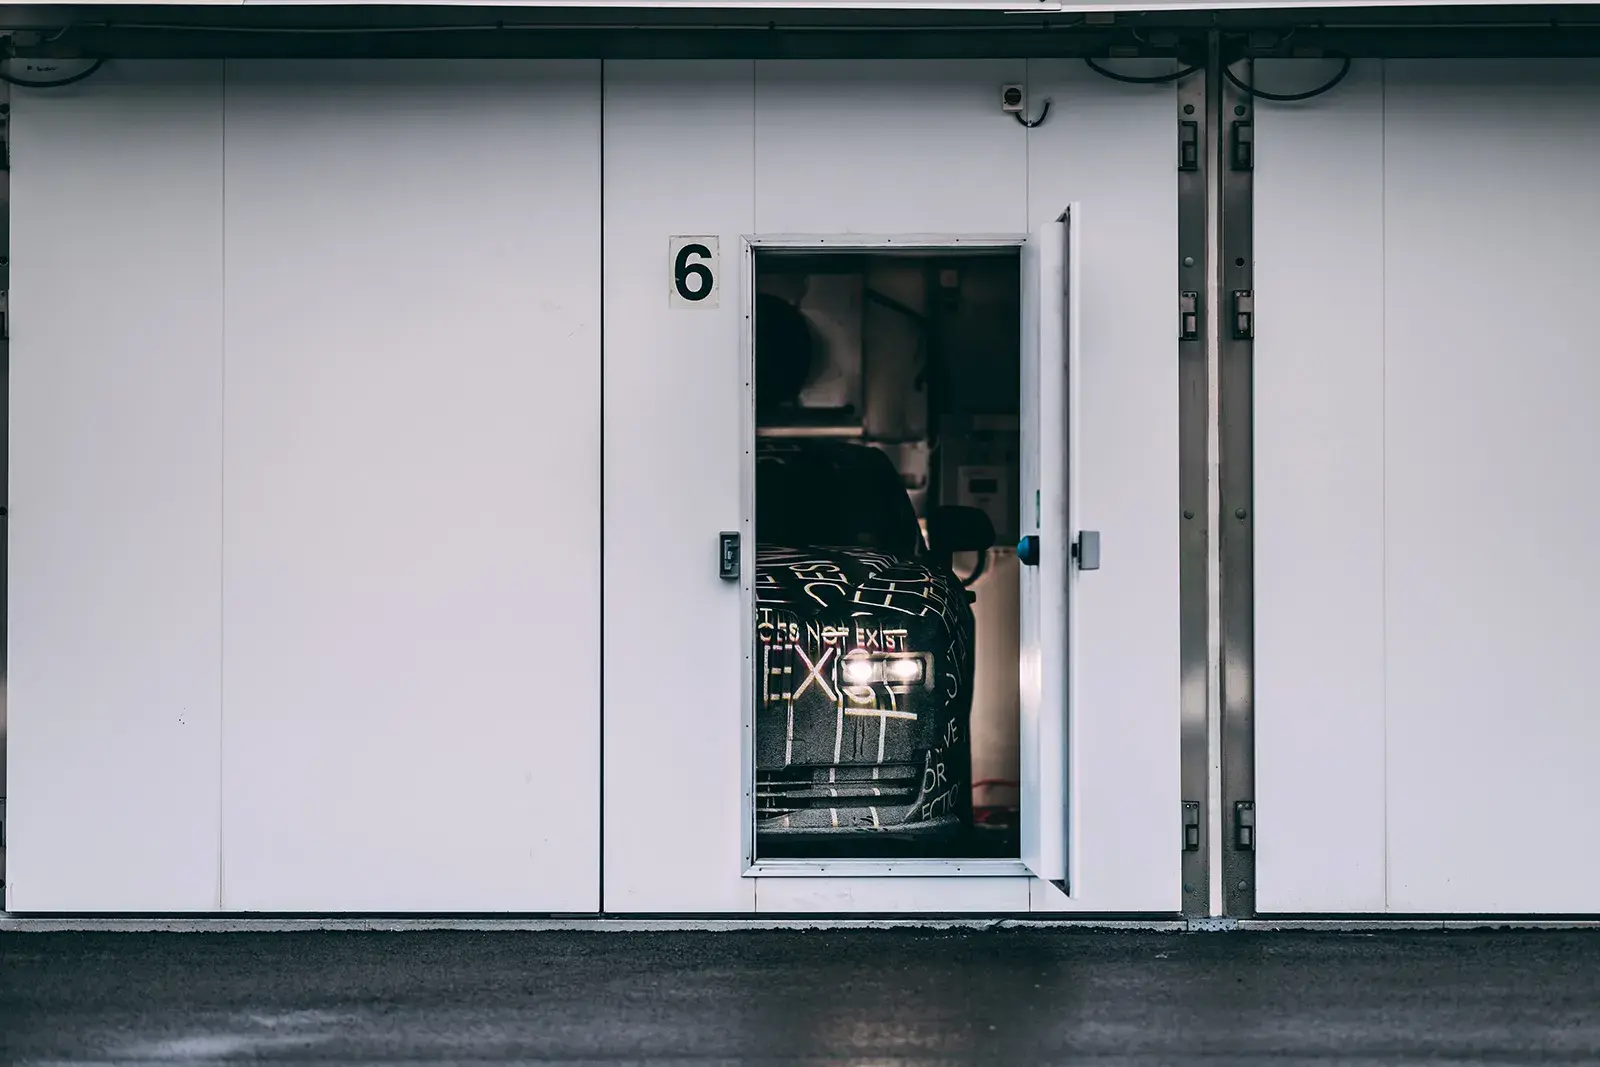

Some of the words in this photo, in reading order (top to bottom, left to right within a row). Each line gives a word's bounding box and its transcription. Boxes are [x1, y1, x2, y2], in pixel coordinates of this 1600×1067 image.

[674, 243, 714, 301] 6
[804, 619, 850, 654] NOT
[855, 621, 909, 653] EXIST
